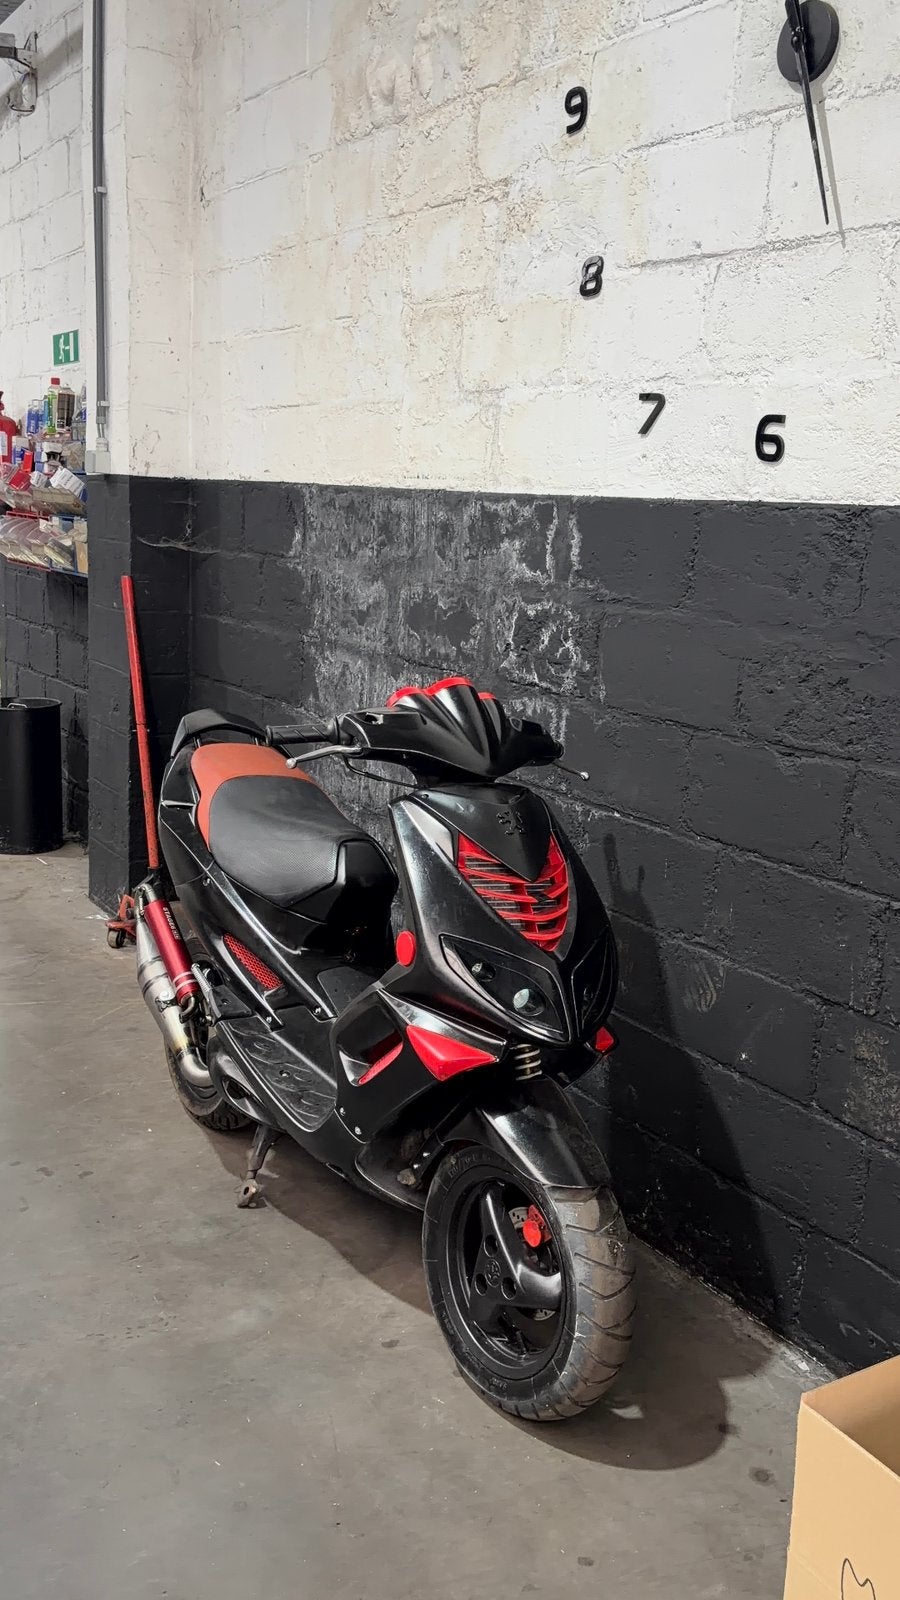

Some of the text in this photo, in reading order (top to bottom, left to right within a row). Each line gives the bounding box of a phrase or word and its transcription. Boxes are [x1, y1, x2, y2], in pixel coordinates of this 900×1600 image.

[564, 86, 588, 135] 9
[579, 255, 604, 298] 8
[638, 392, 666, 435] 7
[755, 414, 786, 463] 6
